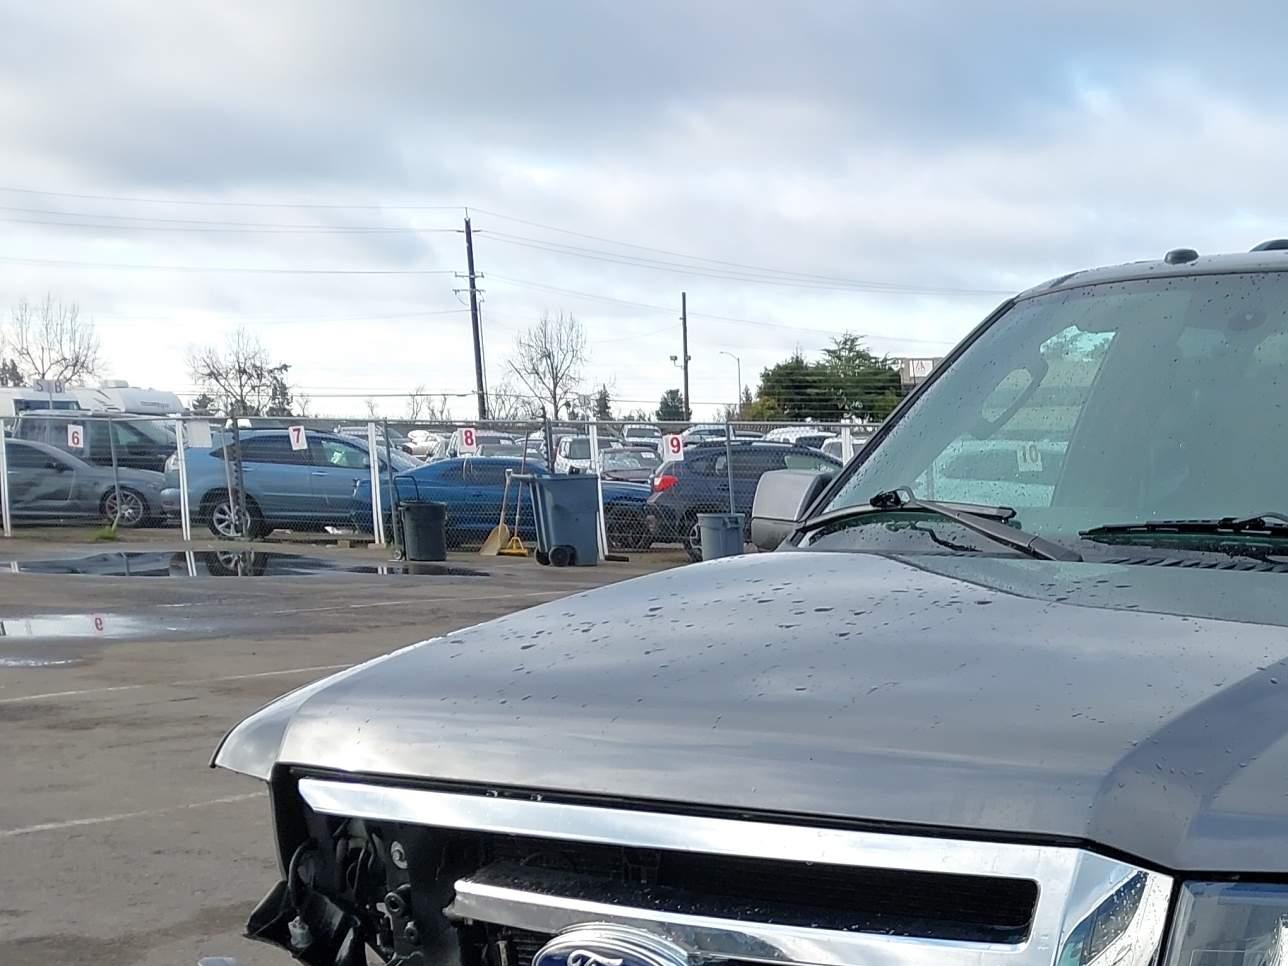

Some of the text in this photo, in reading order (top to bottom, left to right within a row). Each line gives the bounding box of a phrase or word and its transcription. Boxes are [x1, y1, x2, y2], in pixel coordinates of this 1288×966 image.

[71, 431, 80, 446] 6
[293, 428, 302, 444] 7
[463, 429, 474, 446] 8
[670, 436, 681, 454] 9
[1021, 444, 1039, 463] 10
